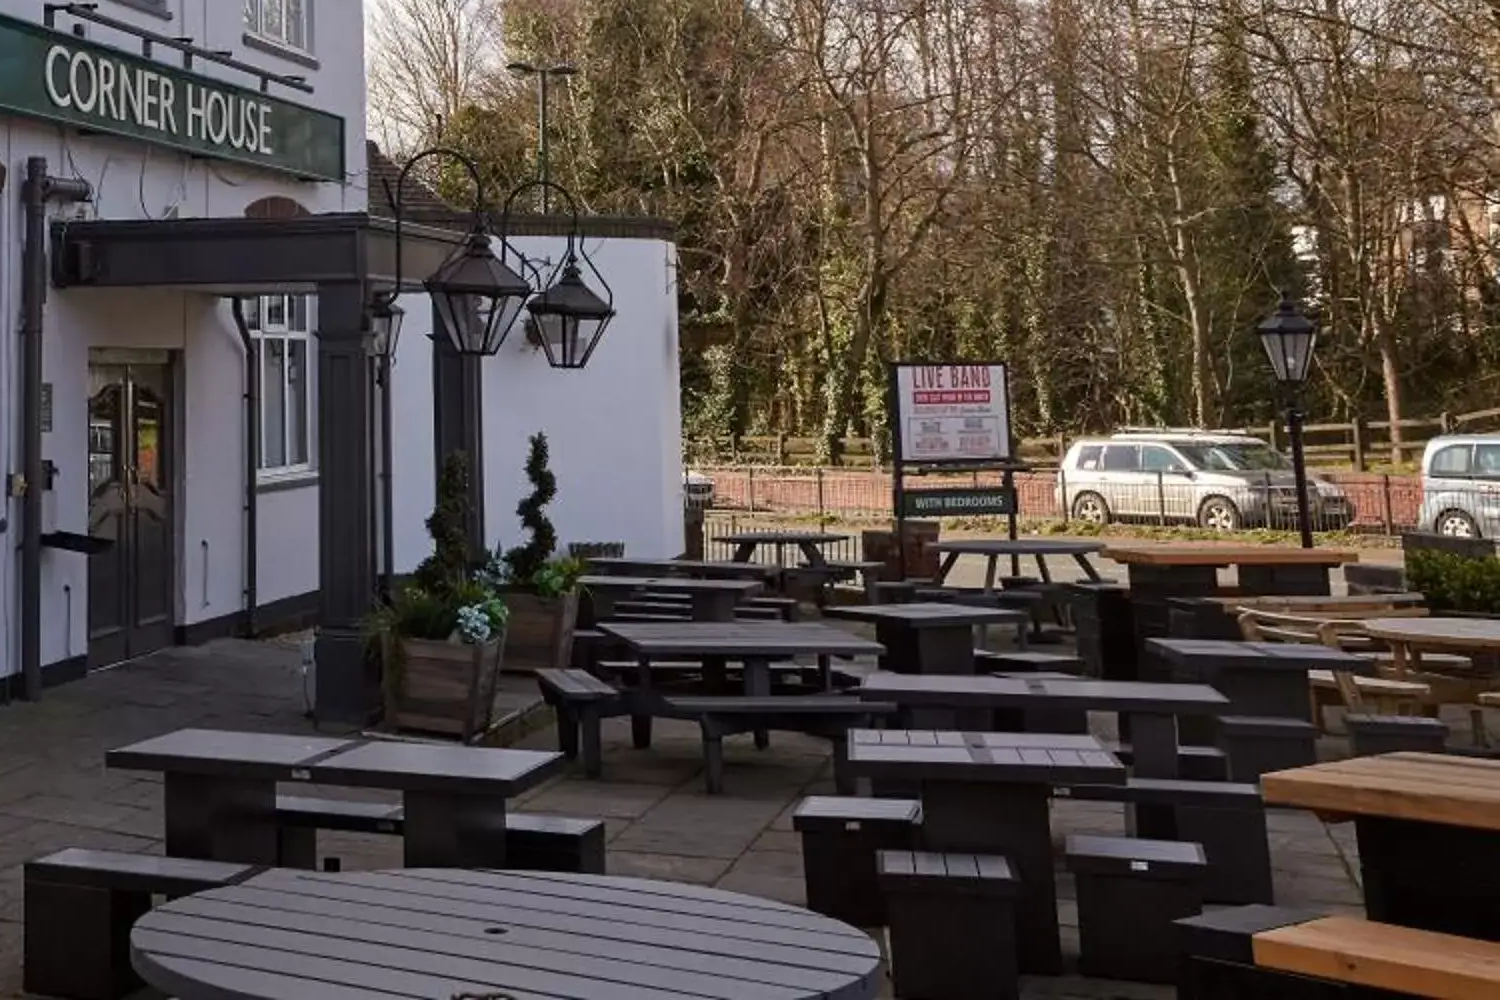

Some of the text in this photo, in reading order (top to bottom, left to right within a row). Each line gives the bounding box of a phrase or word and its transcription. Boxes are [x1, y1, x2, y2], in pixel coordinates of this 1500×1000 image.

[45, 45, 273, 155] CORNER HOUSE
[913, 365, 991, 388] LIVE BAND
[915, 496, 1003, 509] WITH BEDROOMS
